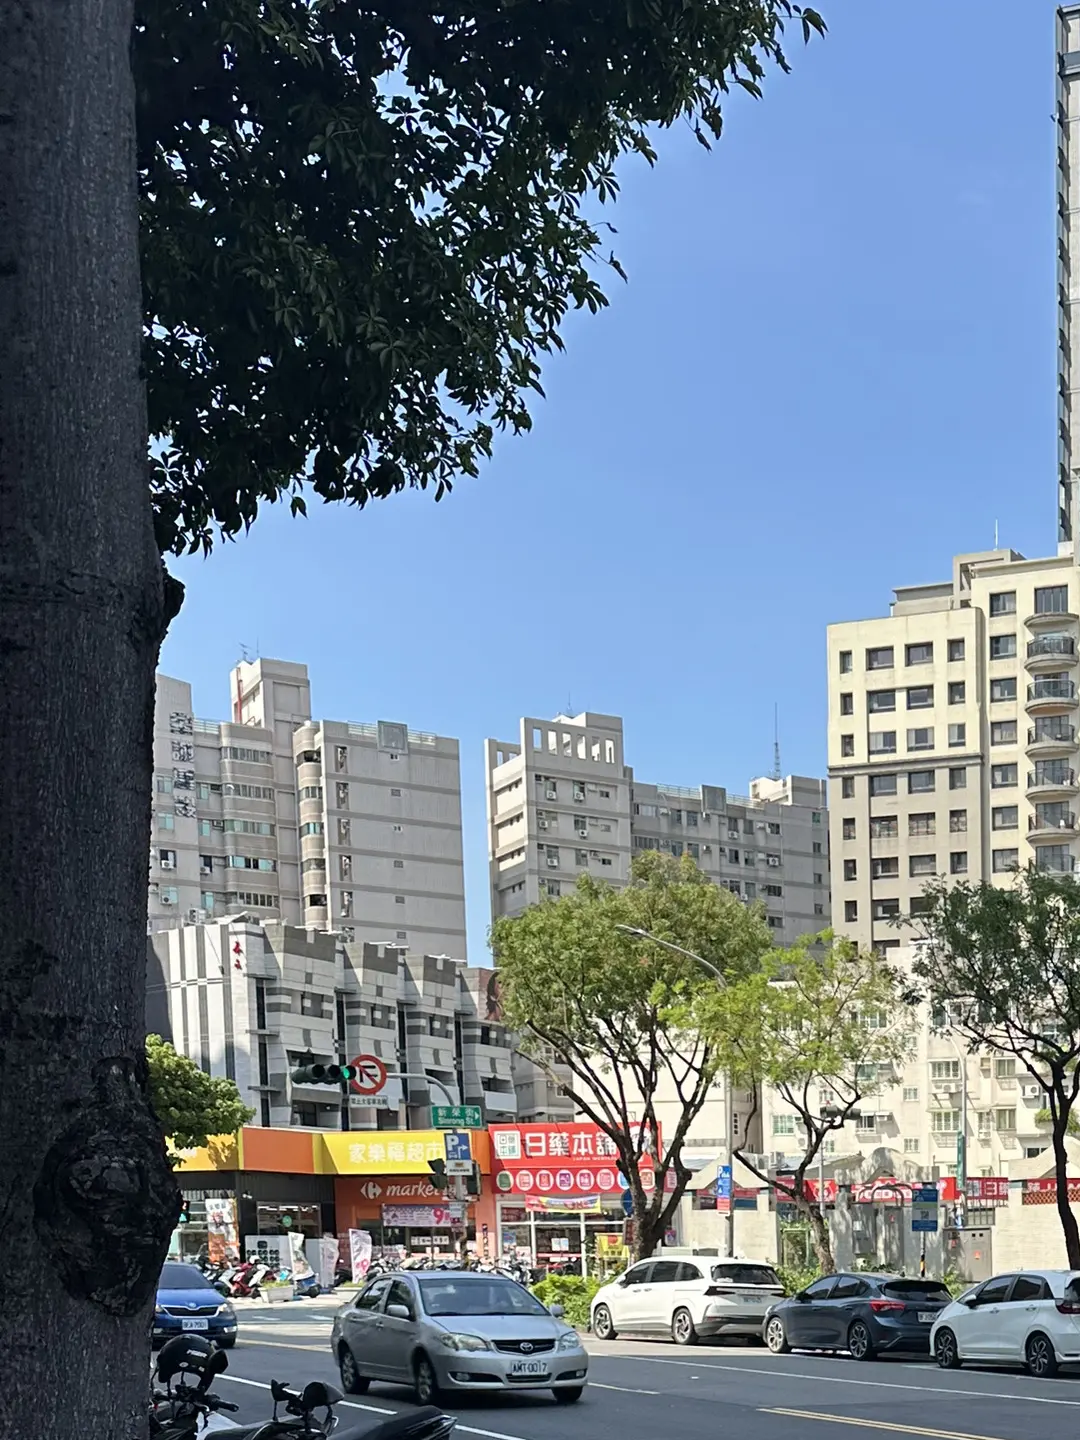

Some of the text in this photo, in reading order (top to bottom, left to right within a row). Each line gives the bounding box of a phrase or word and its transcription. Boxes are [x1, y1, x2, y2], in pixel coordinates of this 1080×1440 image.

[349, 1142, 444, 1163] 家樂福超市
